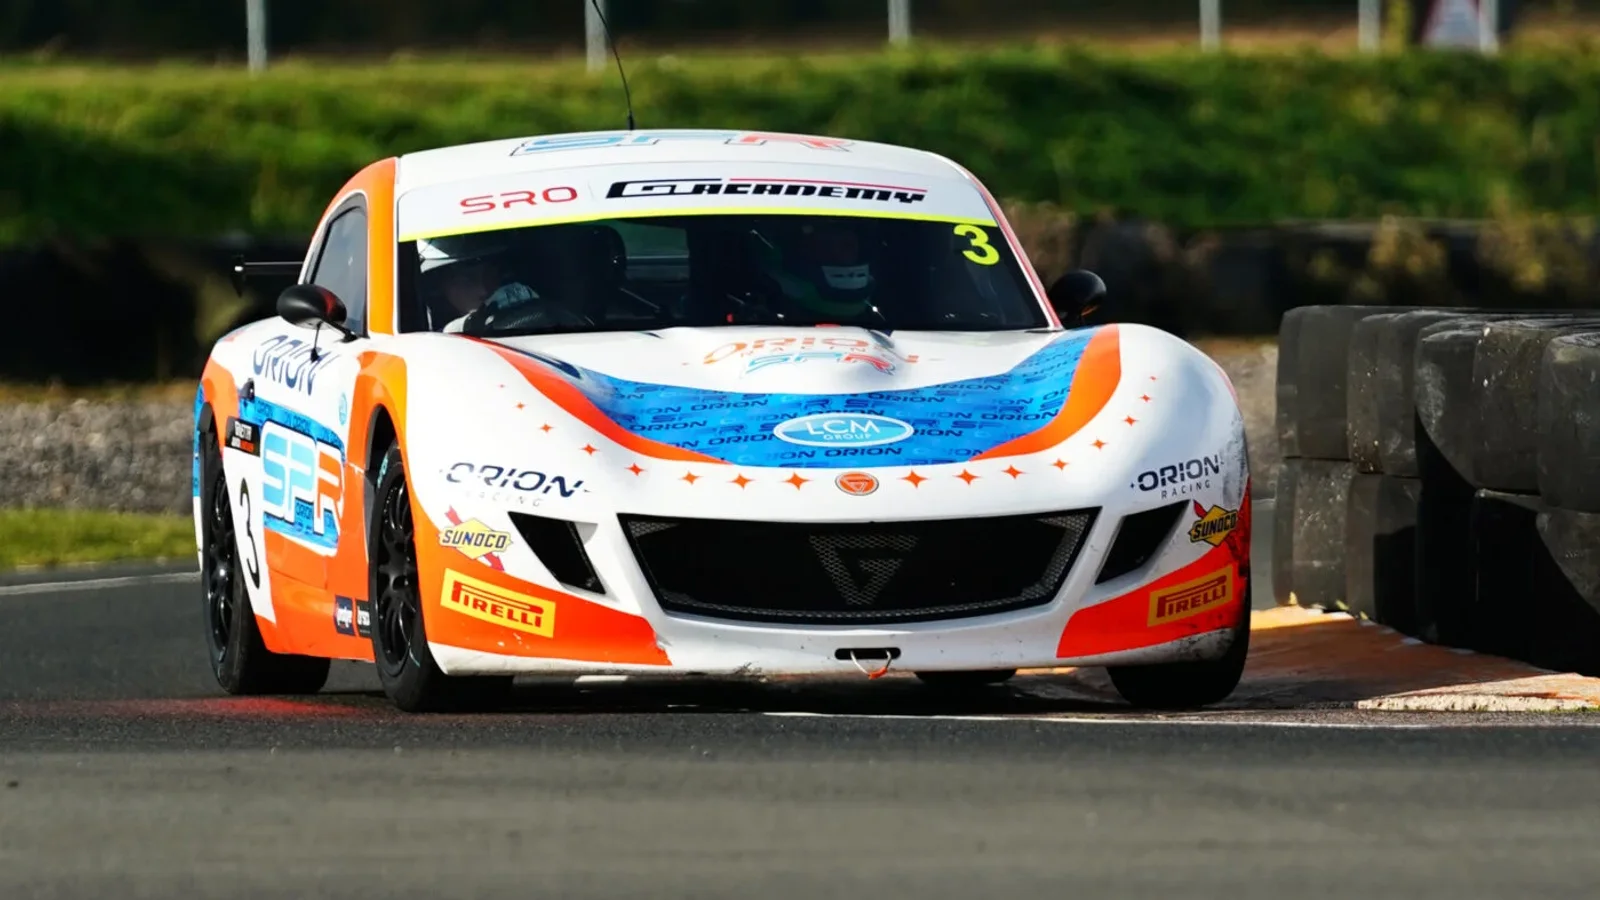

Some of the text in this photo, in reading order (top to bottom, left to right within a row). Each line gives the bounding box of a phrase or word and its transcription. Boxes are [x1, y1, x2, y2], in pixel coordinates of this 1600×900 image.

[460, 186, 578, 214] SRO
[953, 224, 1000, 265] 3
[805, 419, 880, 435] LCM
[824, 447, 903, 457] ORION
[446, 462, 584, 498] ORION
[1137, 454, 1220, 492] ORION
[1161, 480, 1211, 499] RACING
[240, 477, 260, 590] 3
[442, 529, 508, 549] SUNOCO
[1193, 513, 1237, 540] SUNOCO
[451, 580, 544, 628] PIRELLI
[1156, 574, 1227, 618] PIRELLI
